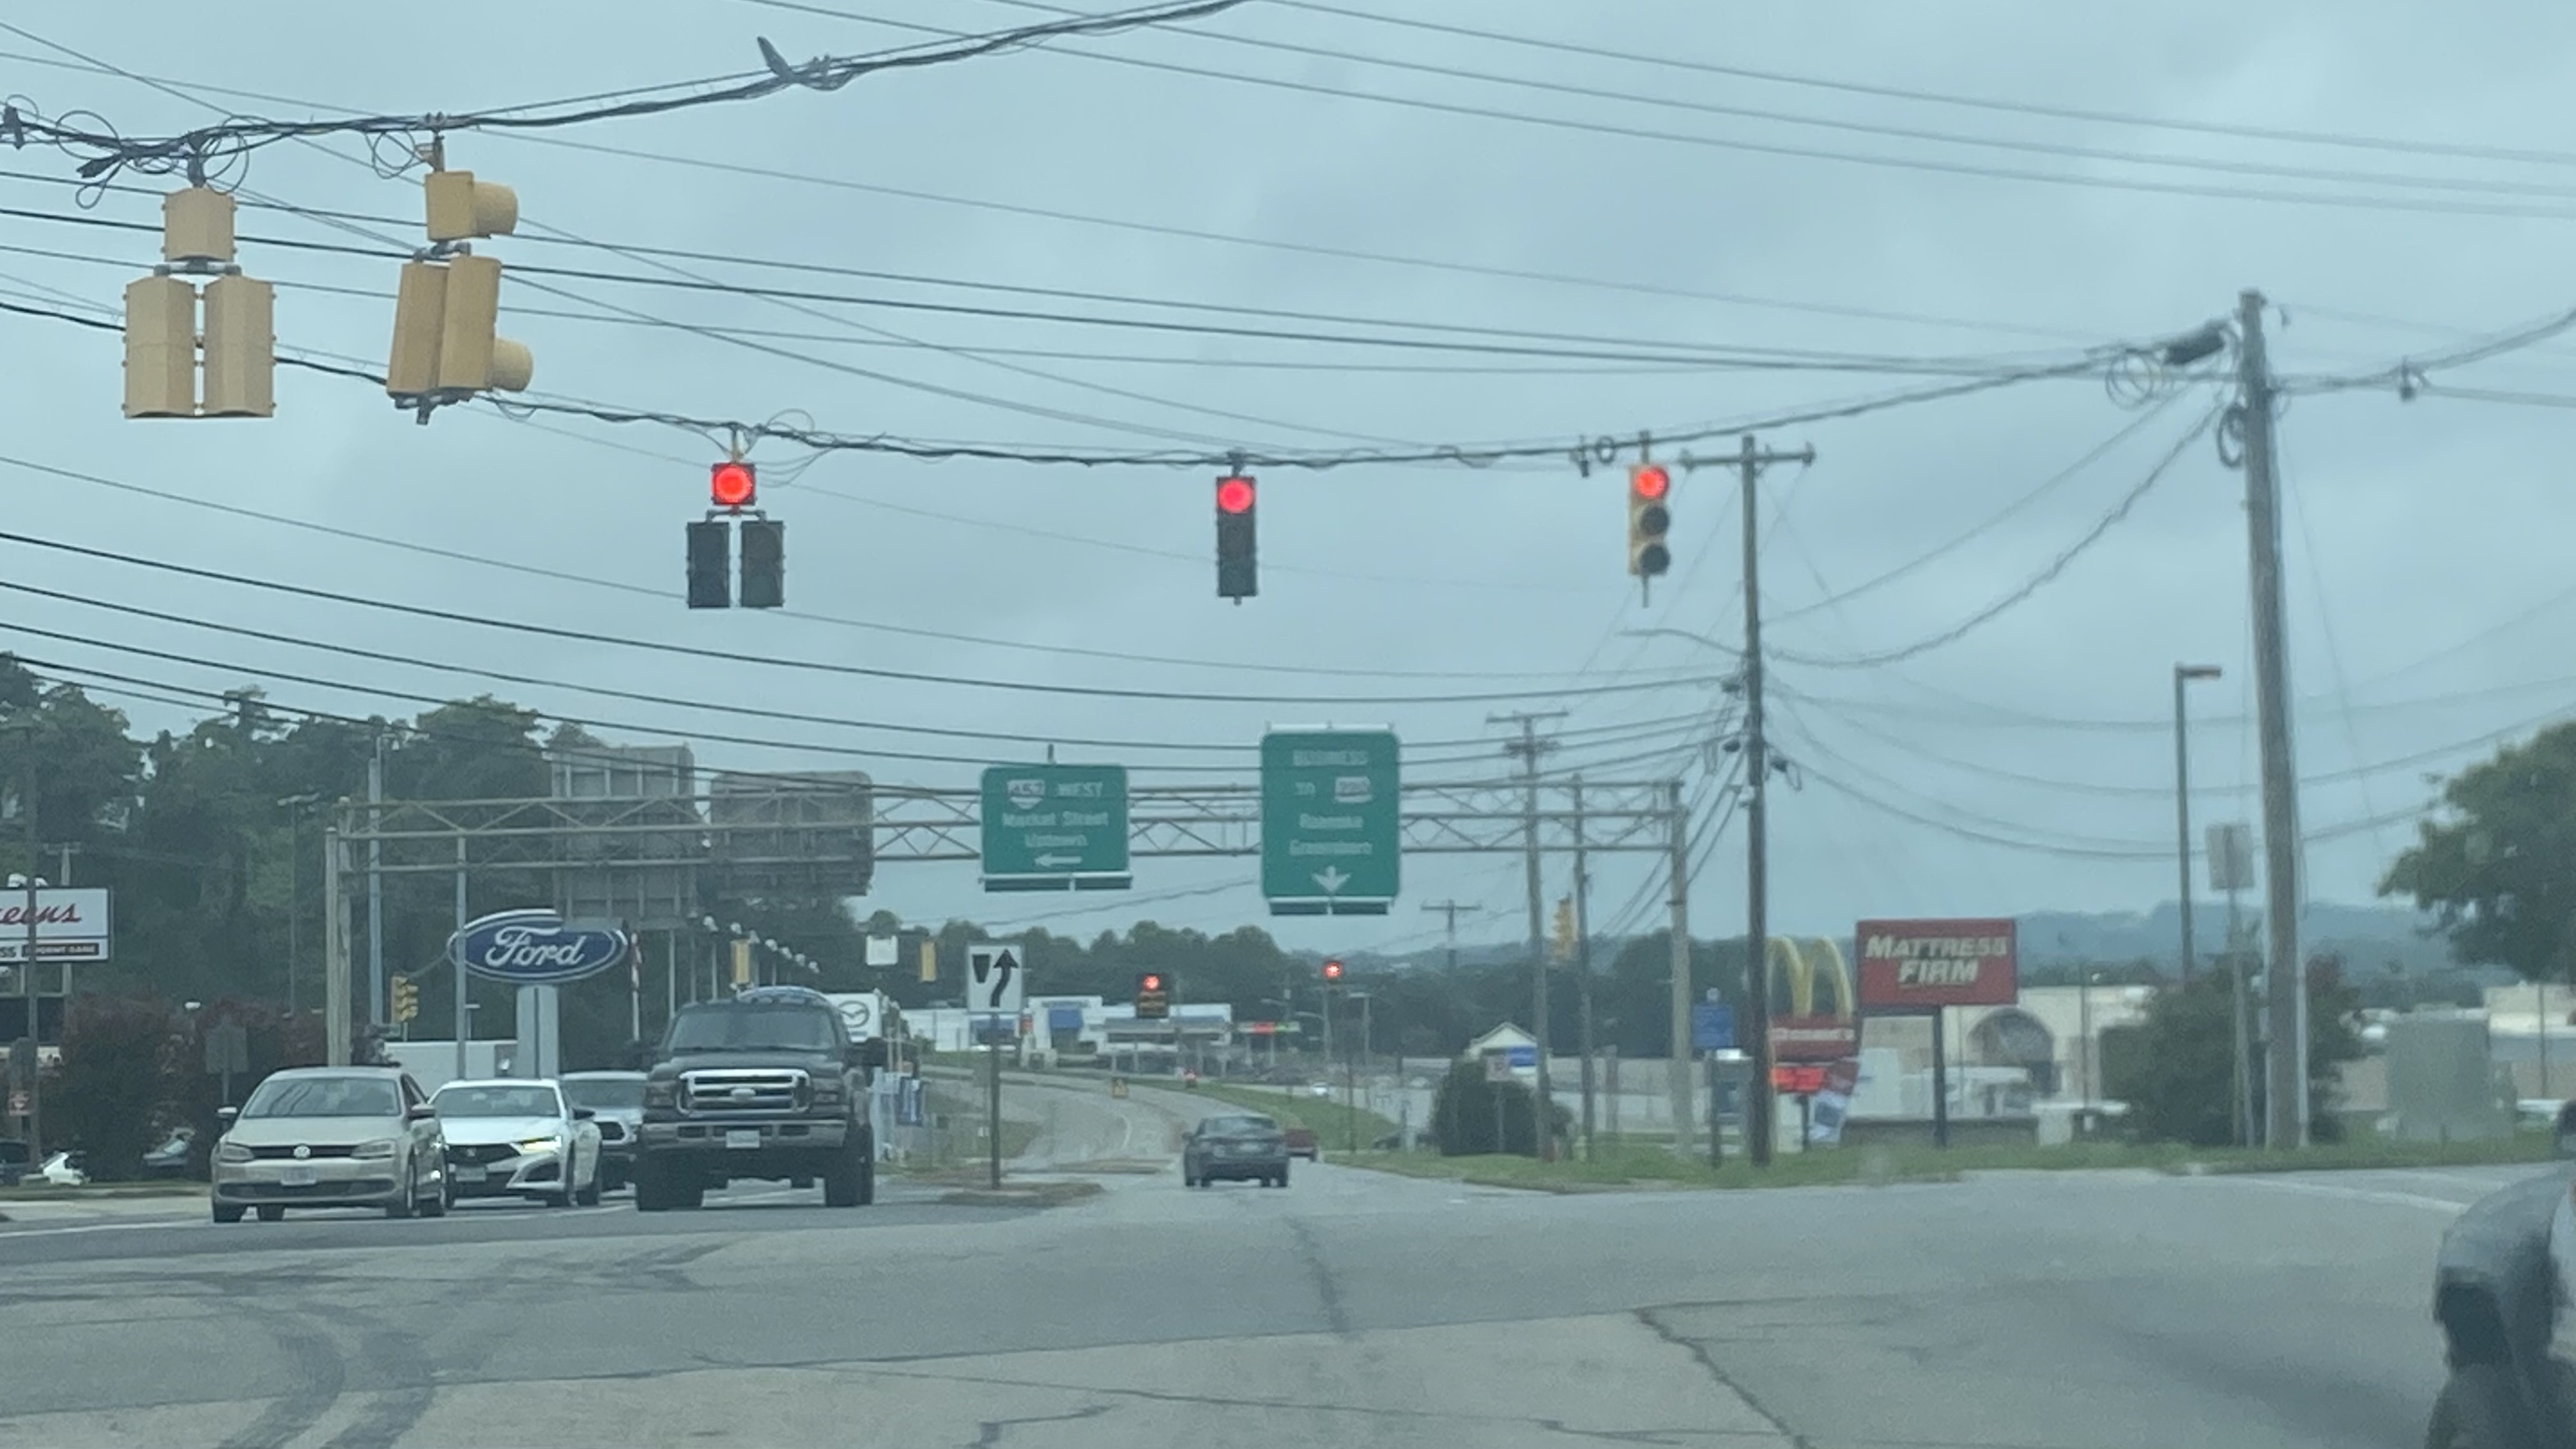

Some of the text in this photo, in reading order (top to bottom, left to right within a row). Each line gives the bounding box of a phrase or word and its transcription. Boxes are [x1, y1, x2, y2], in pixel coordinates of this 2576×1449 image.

[485, 926, 586, 967] Ford
[1865, 935, 2007, 959] MATTRESS
[1898, 959, 1979, 983] FIRM
